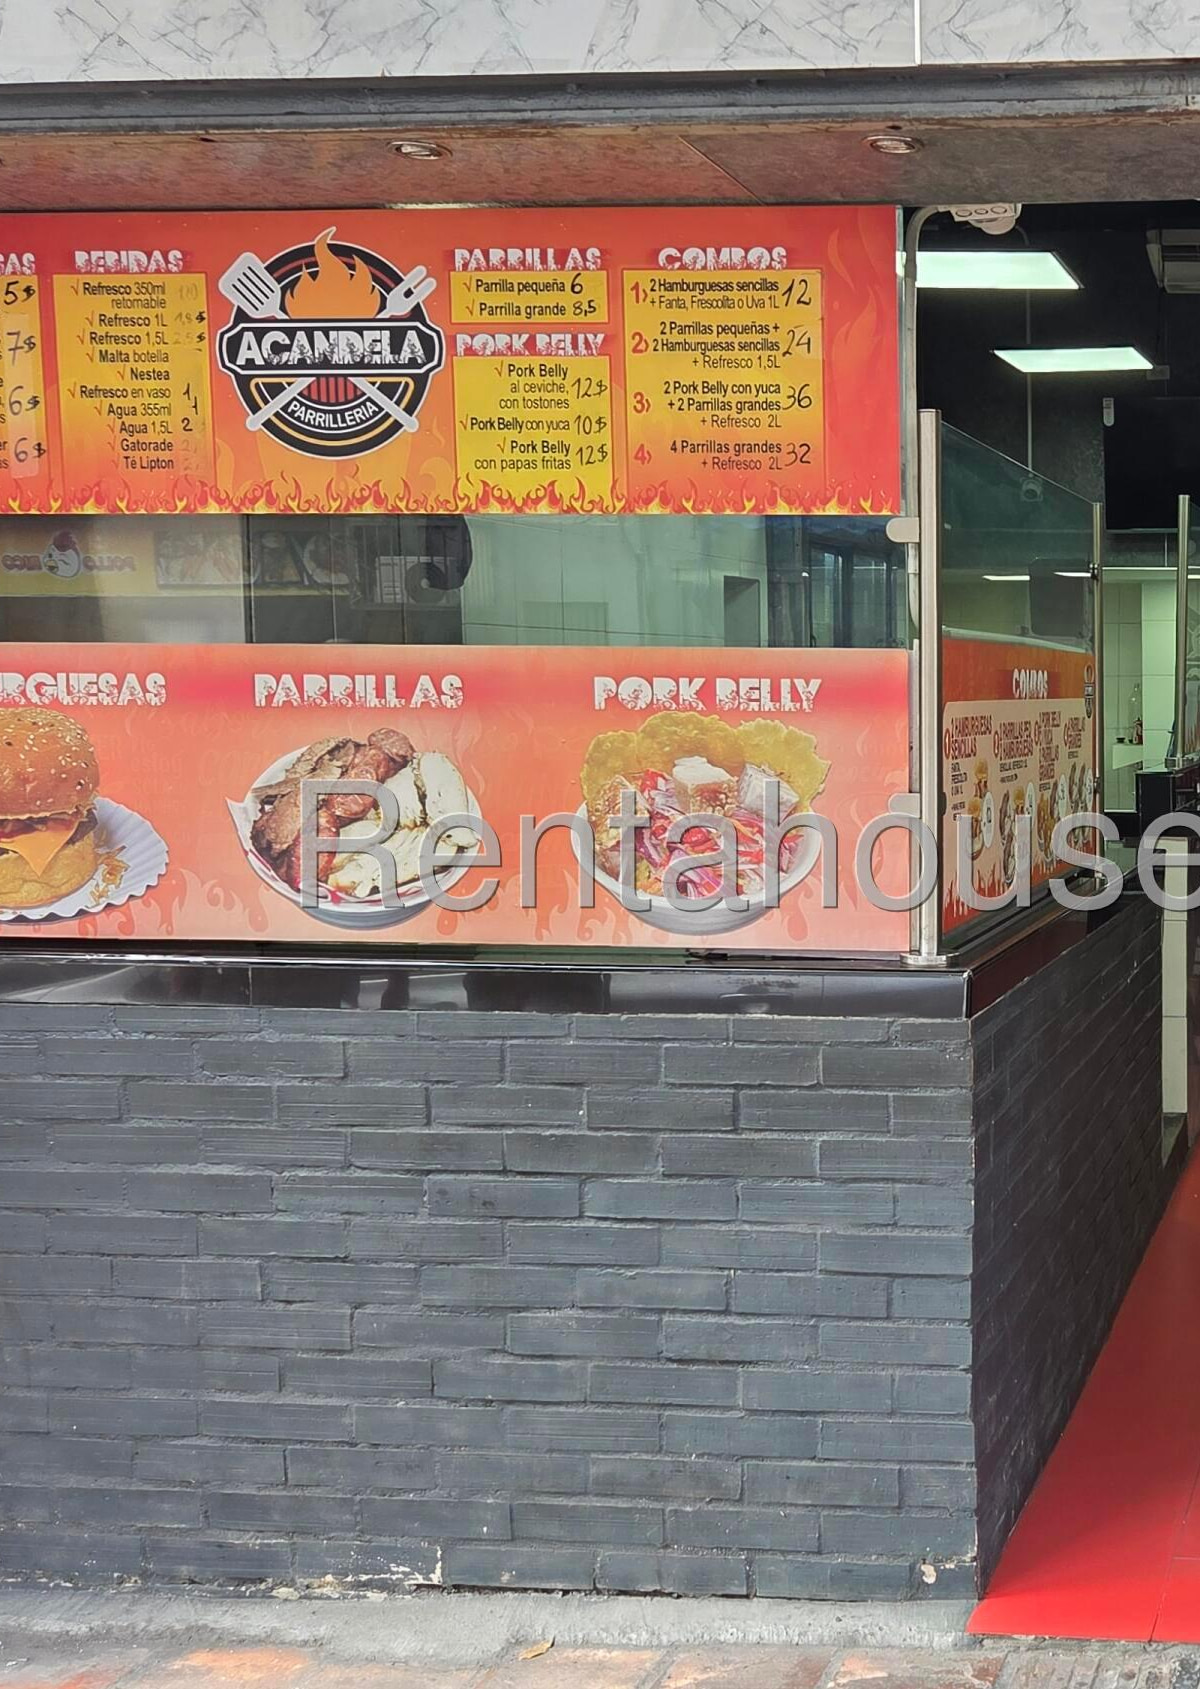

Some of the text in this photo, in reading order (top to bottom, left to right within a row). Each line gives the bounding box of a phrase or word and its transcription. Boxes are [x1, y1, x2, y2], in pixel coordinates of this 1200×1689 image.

[75, 250, 184, 273] BEBIDAS
[454, 248, 601, 271] PARRILLAS
[658, 246, 787, 271] COMBOS
[83, 282, 131, 296] Refresco
[134, 282, 166, 296] 350ml
[475, 278, 566, 298] Parrilla pequeña
[570, 273, 584, 295] 6
[650, 278, 780, 295] 2 Hamburguesas sencillas
[781, 278, 812, 308] 12
[111, 297, 166, 309] retornable
[479, 302, 566, 320] Parrilla grande
[573, 300, 597, 317] 8,5
[658, 295, 689, 311] Fanta,
[737, 299, 744, 309] o
[746, 295, 765, 309] Uva
[768, 295, 780, 308] 1L
[99, 313, 167, 327] Refresco 1L
[660, 321, 667, 335] 2
[669, 321, 714, 335] Parrillas
[716, 321, 770, 339] pequeñas
[90, 331, 168, 347] Refresco 1,5L
[456, 333, 605, 357] PORK BELLY
[652, 338, 780, 355] 2 Hamburguesas sencillas
[782, 327, 812, 357] 24
[99, 350, 169, 363] Malta botella
[236, 330, 427, 366] ACANDELA
[703, 354, 753, 369] Refresco
[757, 354, 781, 371] 1,5L
[130, 367, 170, 381] Nestea
[508, 363, 568, 382] Pork Belly
[80, 384, 171, 398] Refresco en vaso
[510, 381, 520, 394] al
[571, 377, 608, 400] 12$
[664, 381, 781, 399] 2 Pork Belly con yuca
[499, 397, 570, 410] con tostones
[782, 383, 813, 411] 36
[107, 402, 172, 418] Agua 355ml
[287, 401, 379, 429] PARRILLERIA
[677, 398, 684, 411] 2
[687, 398, 733, 411] Parrillas
[735, 398, 781, 415] grandes
[119, 420, 173, 436] Agua 1,5L
[470, 416, 570, 435] Pork Belly con yuca
[573, 414, 607, 436] 10$
[711, 414, 762, 429] Refresco
[767, 414, 782, 428] 2L
[121, 439, 173, 452] Gatorade
[510, 440, 571, 457] Pork Belly
[670, 440, 782, 457] 4 Parrillas grandes
[575, 443, 608, 467] 12$
[785, 442, 812, 467] 32
[124, 456, 138, 470] Té
[140, 457, 174, 473] Lipton
[475, 457, 572, 473] con papas fritas
[712, 457, 762, 471] Refresco
[768, 457, 783, 471] 2L
[255, 673, 464, 708] PARRILLAS
[1012, 668, 1048, 699] COMBOS
[593, 676, 822, 712] PORK BELLY
